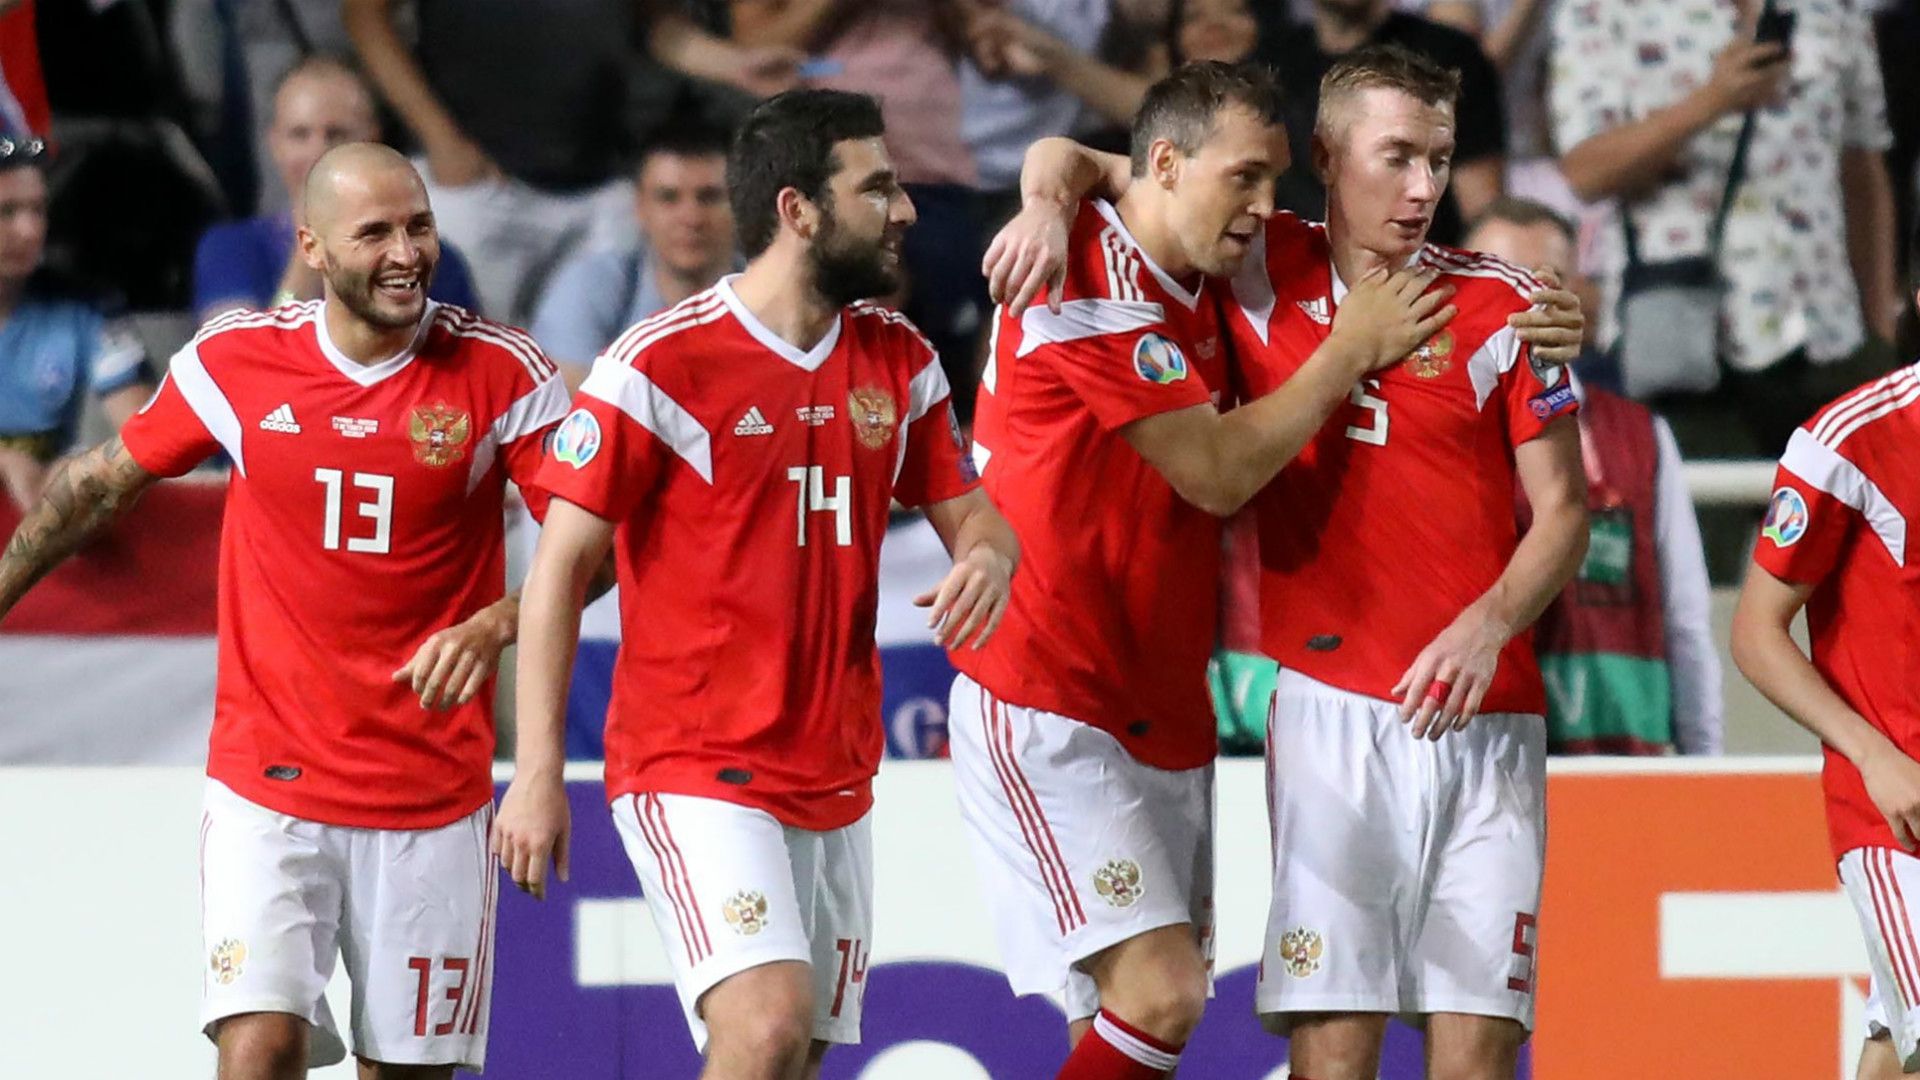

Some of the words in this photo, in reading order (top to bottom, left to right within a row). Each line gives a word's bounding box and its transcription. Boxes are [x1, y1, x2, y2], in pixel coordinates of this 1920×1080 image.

[259, 420, 301, 434] adidas
[734, 424, 774, 436] adidas
[1345, 379, 1389, 446] 5
[314, 467, 394, 554] 13
[787, 465, 852, 546] 14
[830, 939, 868, 1018] 14
[1507, 911, 1536, 994] 5
[409, 956, 469, 1036] 13
